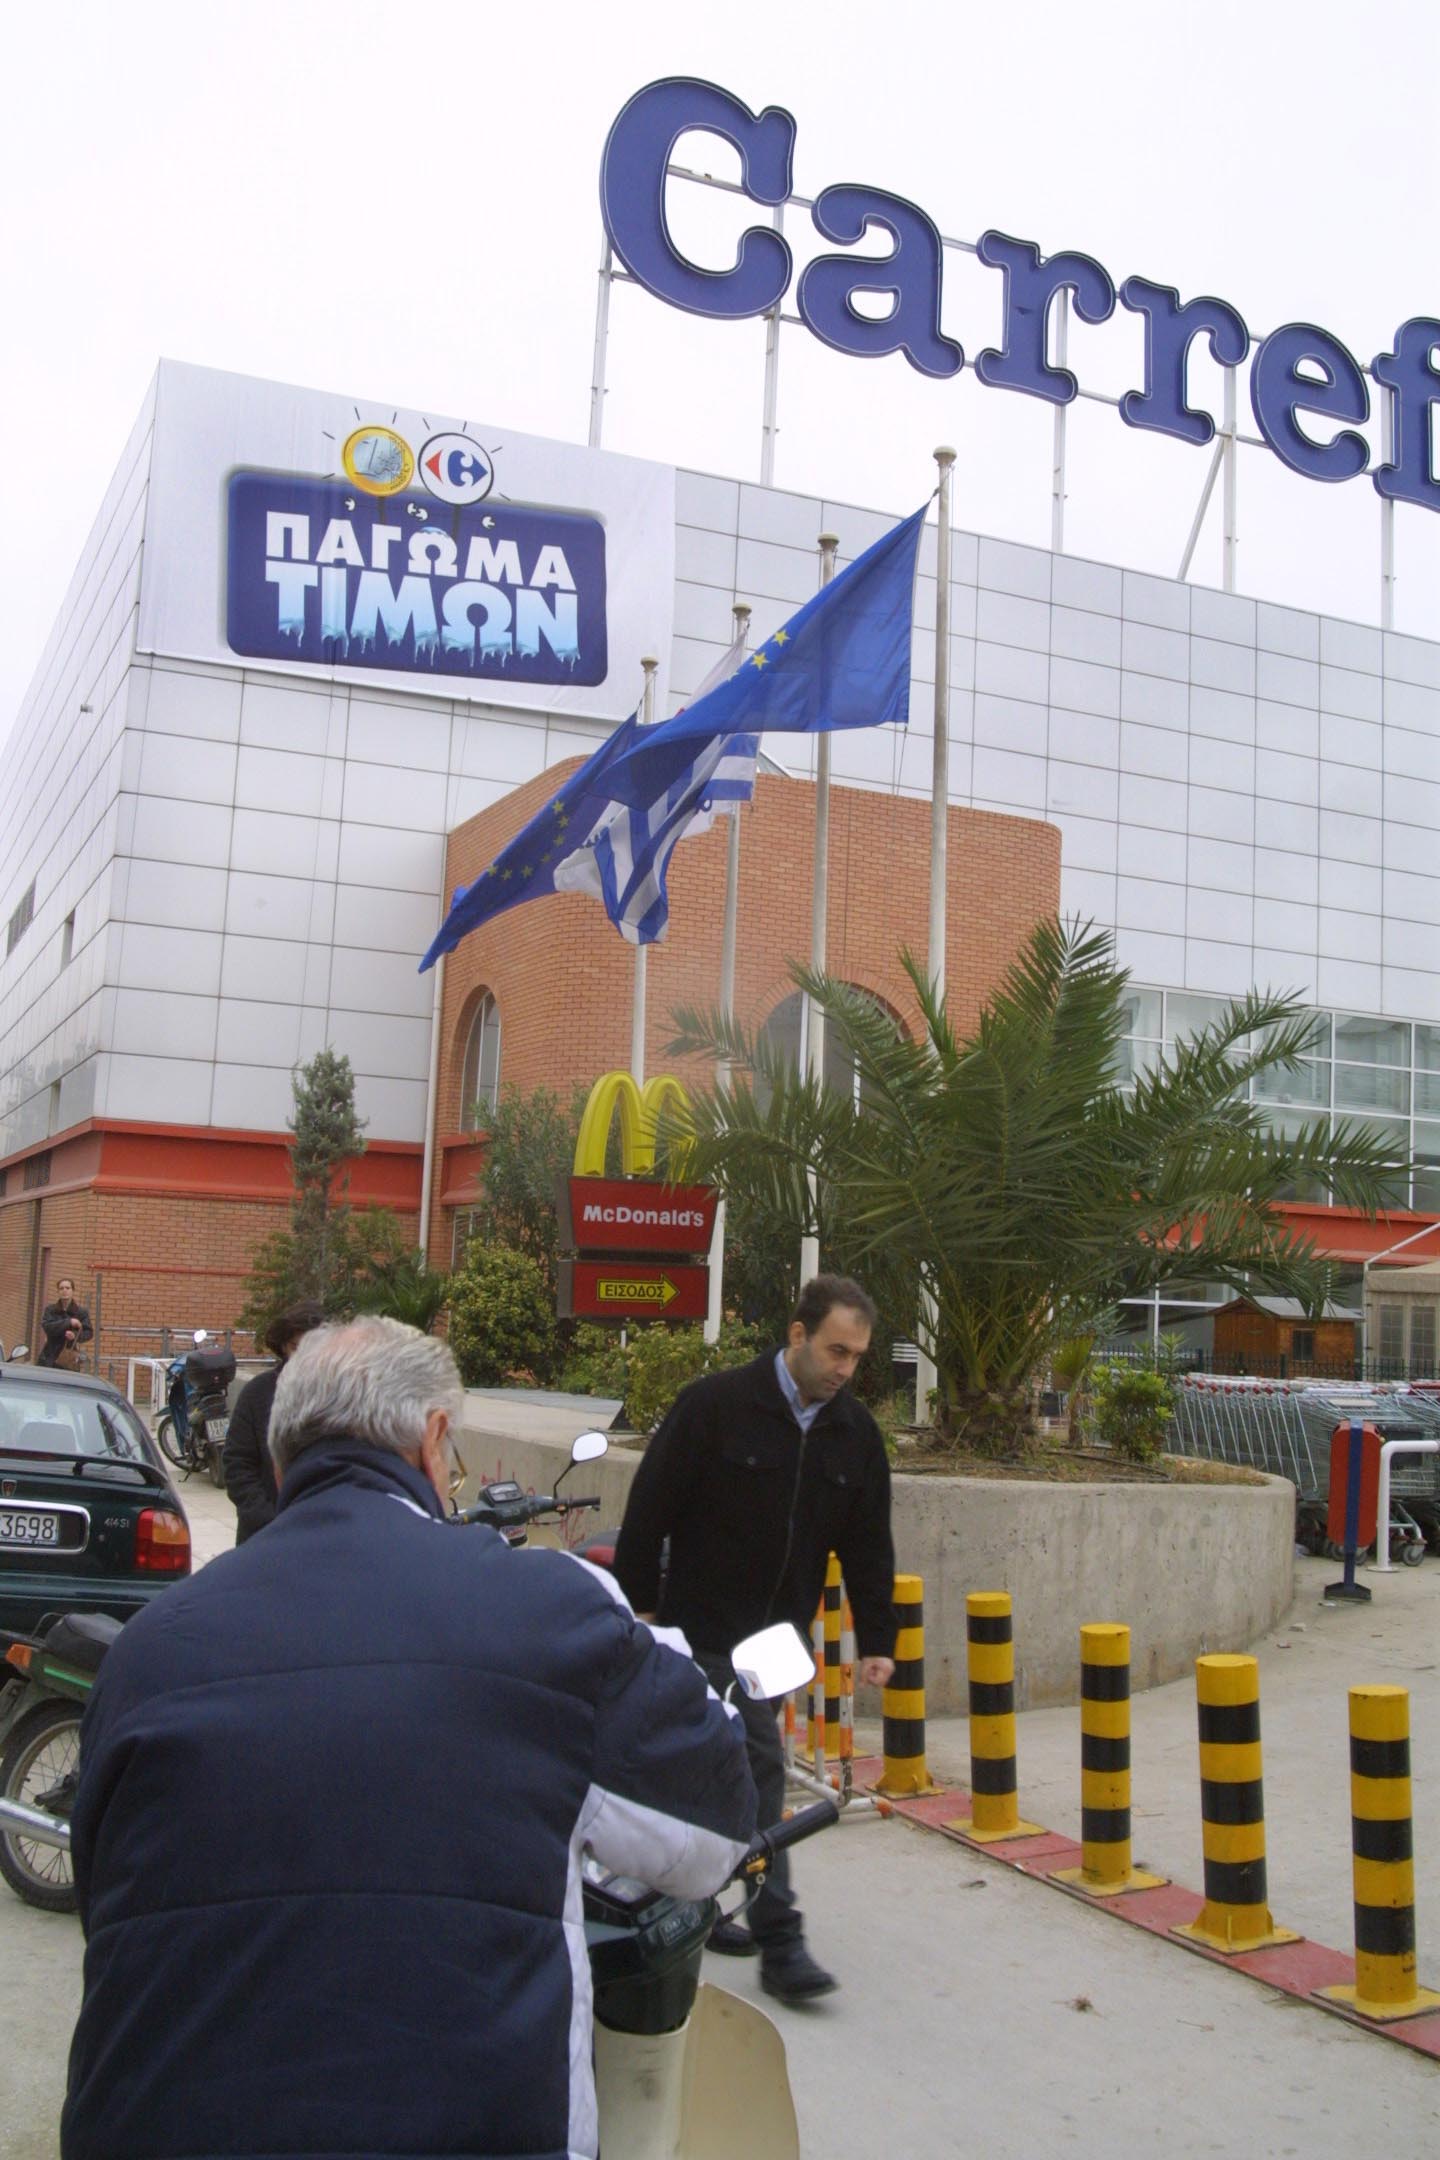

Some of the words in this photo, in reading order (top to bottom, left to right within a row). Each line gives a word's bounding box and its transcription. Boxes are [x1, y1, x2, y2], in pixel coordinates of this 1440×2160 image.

[600, 76, 1440, 513] Carref
[265, 511, 577, 591] ΠΑΓΩΜΑ
[265, 560, 581, 668] ΤΙΜΩΝ
[583, 1205, 704, 1227] McDonald's
[604, 1284, 666, 1298] ΕΙΣΟΔΟΣ
[0, 1514, 54, 1540] 3698
